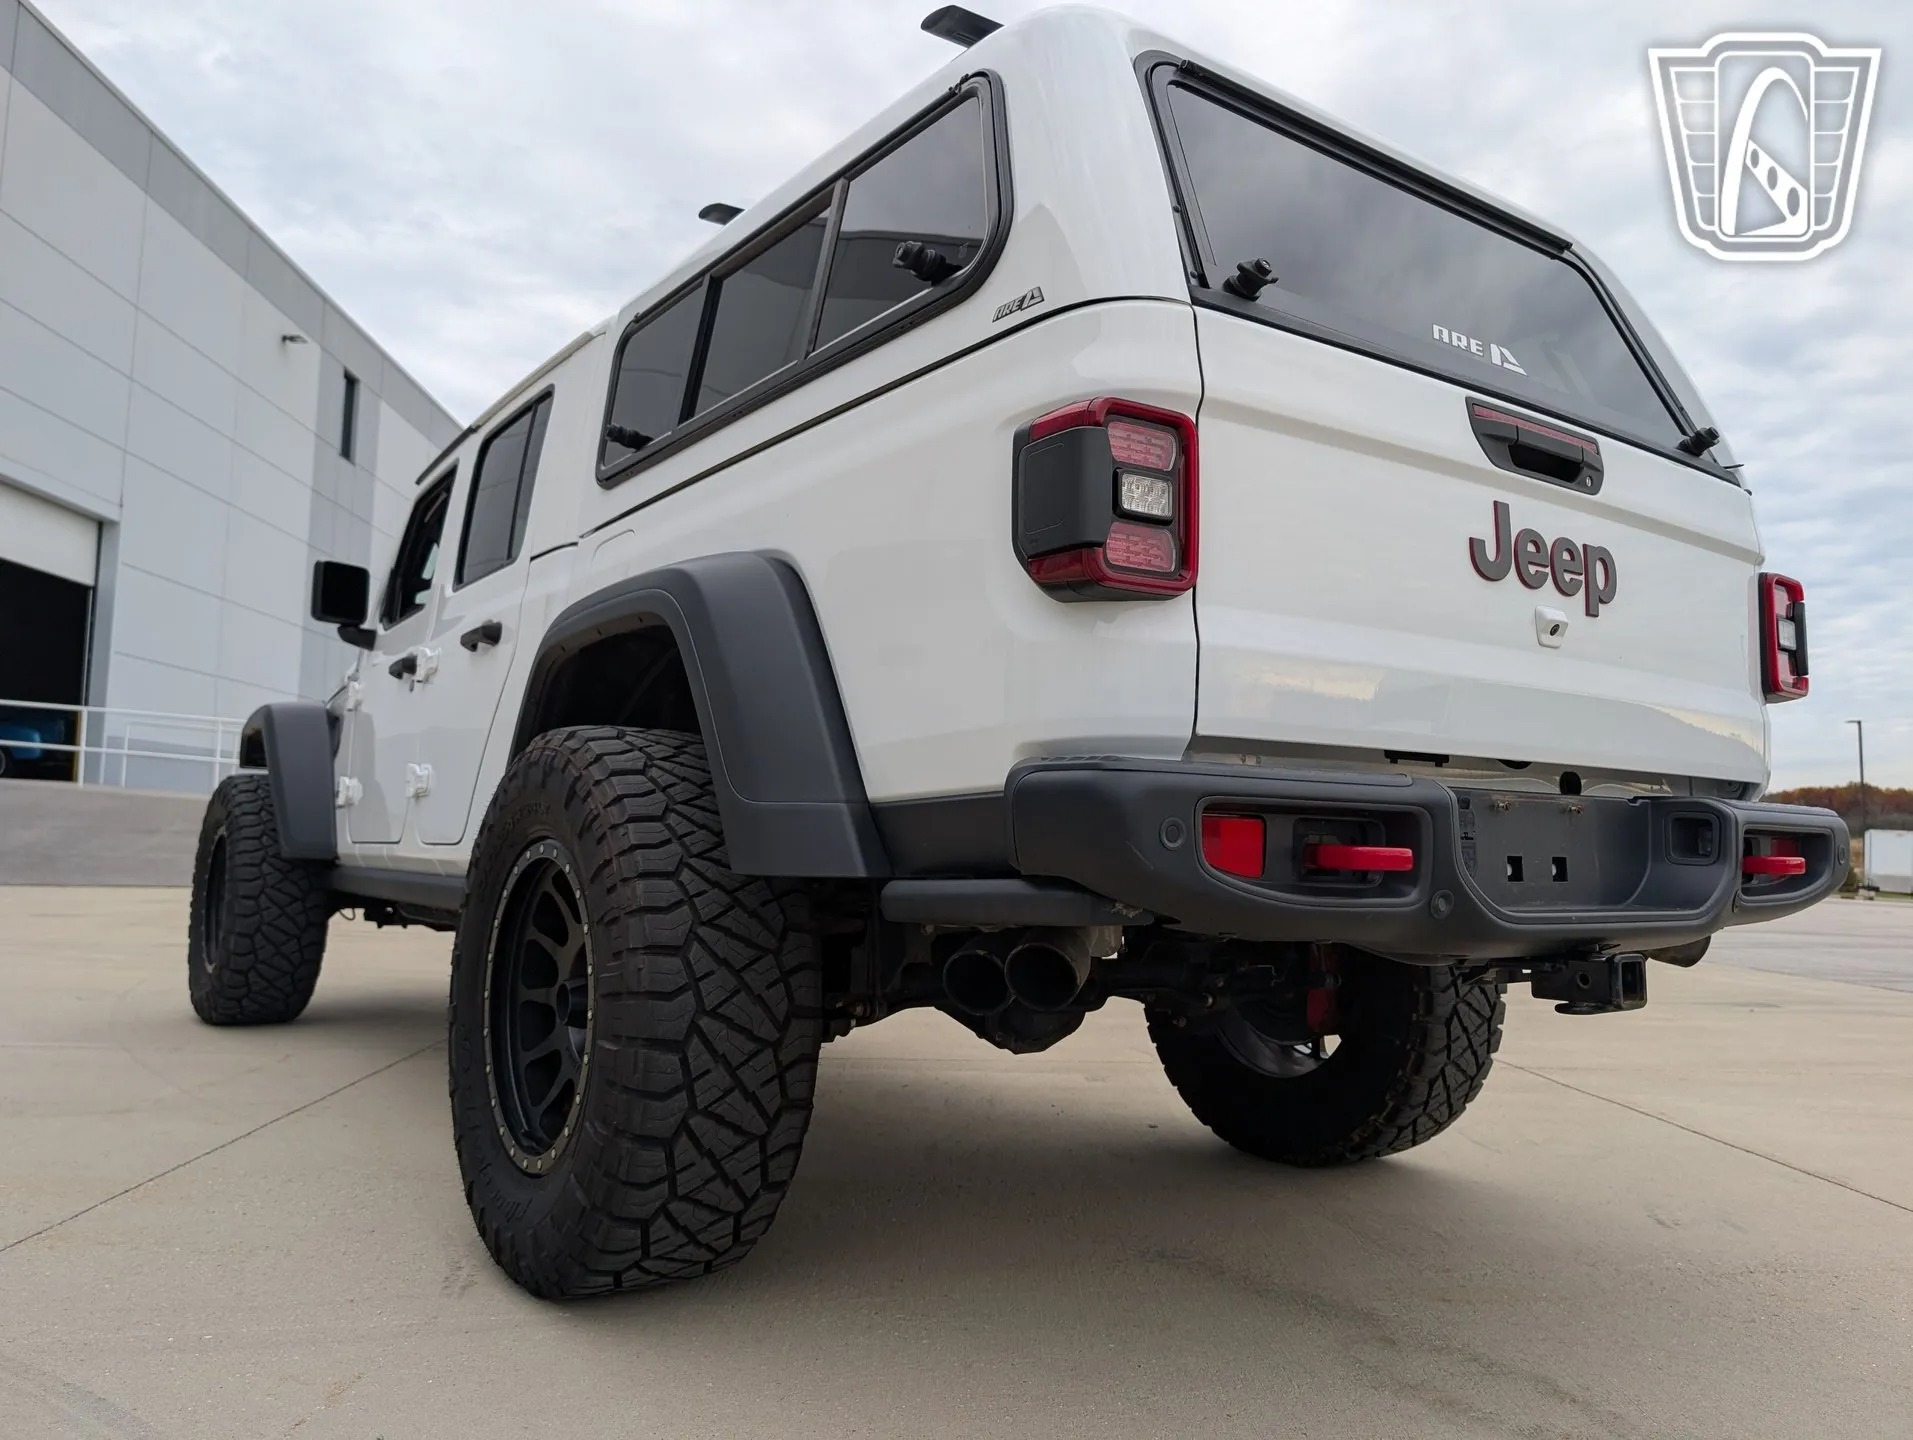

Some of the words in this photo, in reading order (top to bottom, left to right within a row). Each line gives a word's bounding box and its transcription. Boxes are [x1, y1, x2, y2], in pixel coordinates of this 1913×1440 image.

[993, 297, 1023, 322] ARE
[1432, 323, 1484, 357] ARE
[1469, 500, 1617, 617] Jeep
